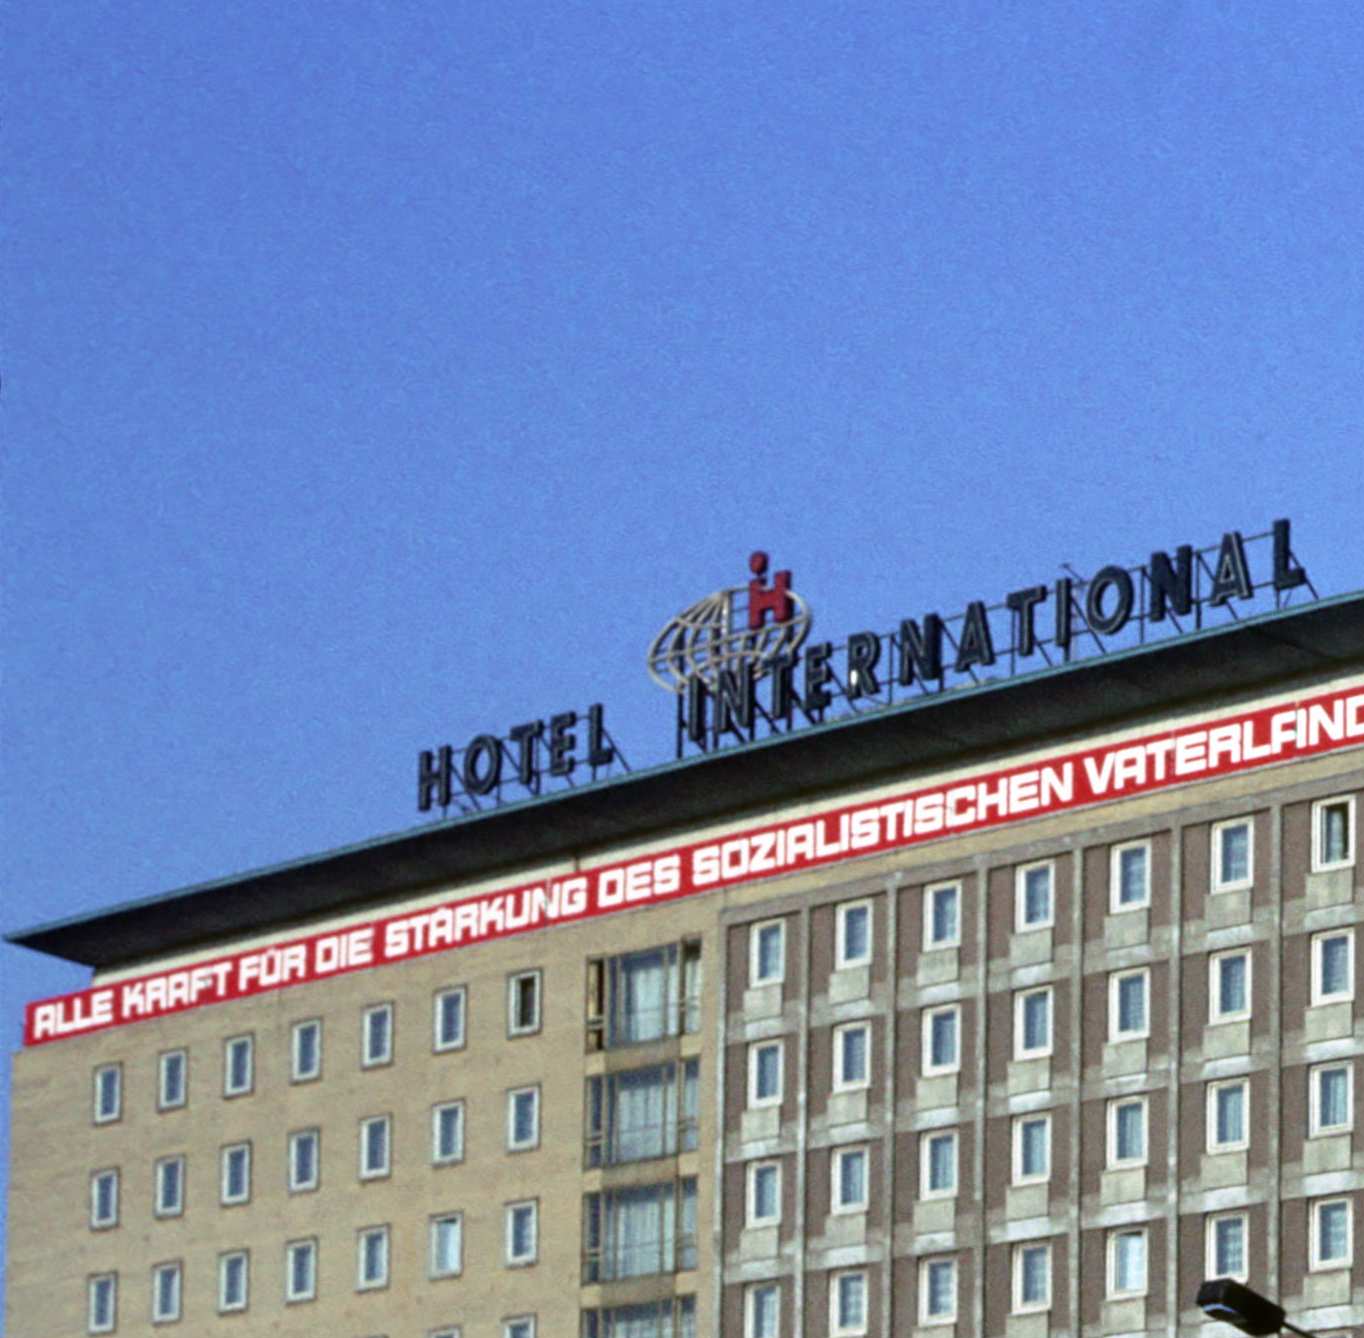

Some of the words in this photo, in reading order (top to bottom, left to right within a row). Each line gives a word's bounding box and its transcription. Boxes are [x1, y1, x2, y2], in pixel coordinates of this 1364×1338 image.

[418, 702, 614, 813] HOTEL
[688, 518, 1306, 743] INTERNATIONAL
[33, 990, 114, 1039] ALLE
[121, 960, 233, 1018] KRAFT
[239, 943, 308, 992] FÜR
[314, 927, 374, 973] DIE
[384, 876, 589, 958] STÄRKUNG
[597, 854, 681, 908] DES
[691, 762, 1074, 886] SOZIALISTISCHEN
